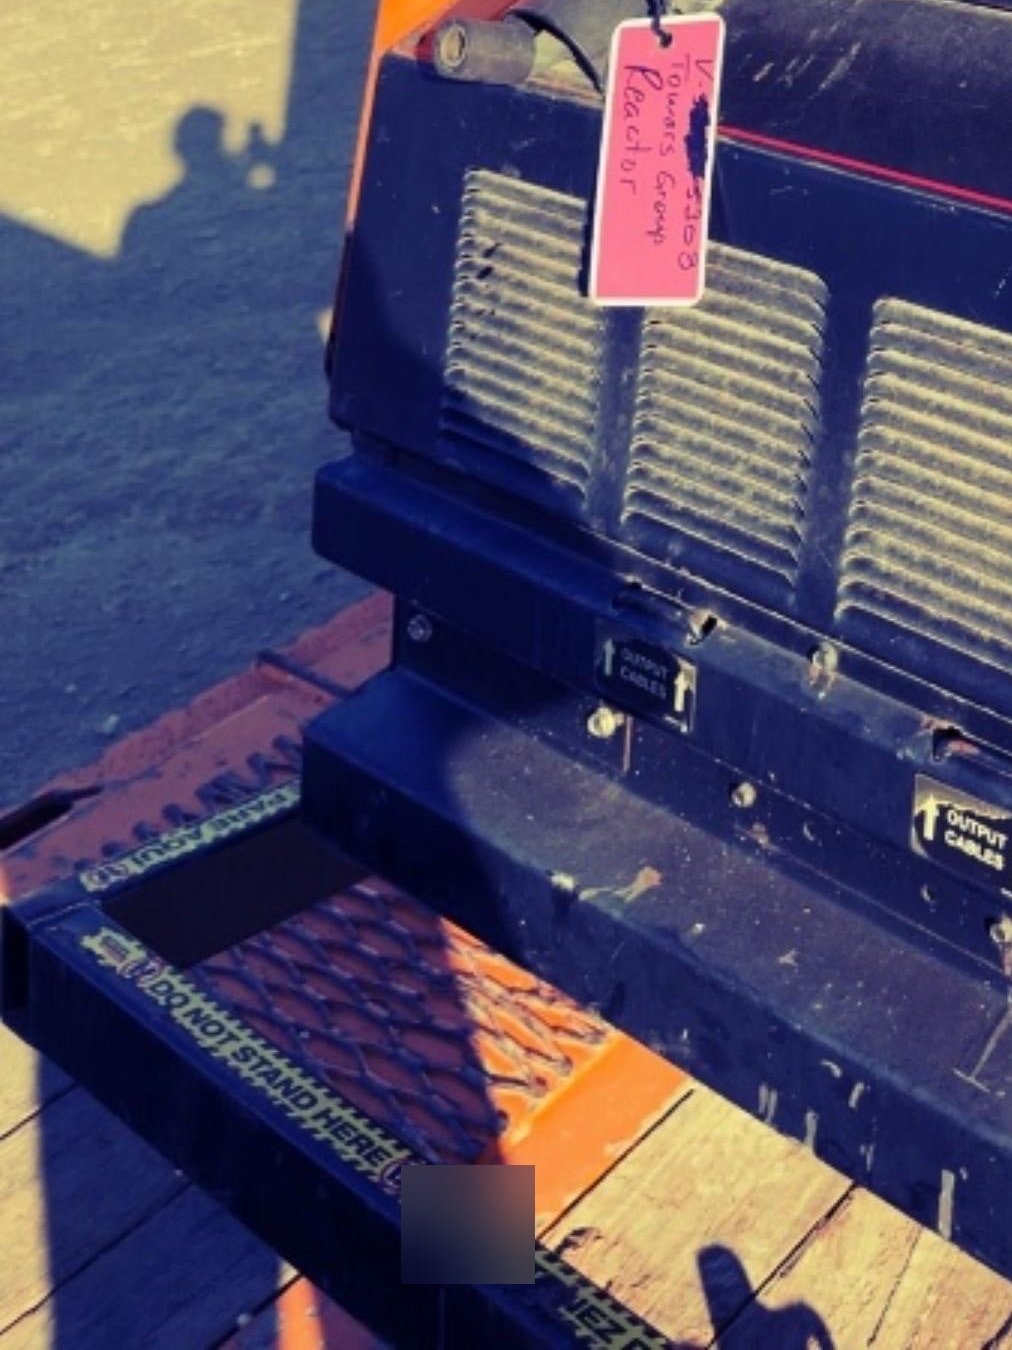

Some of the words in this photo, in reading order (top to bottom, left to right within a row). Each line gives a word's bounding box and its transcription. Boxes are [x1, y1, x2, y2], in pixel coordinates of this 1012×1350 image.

[619, 65, 664, 195] Reactor
[944, 829, 1004, 872] CABLES
[946, 809, 1008, 850] OUTPUT
[149, 979, 190, 1011] DO
[184, 1007, 238, 1046] NOT
[230, 1045, 318, 1111] STAND
[311, 1105, 390, 1169] HERE
